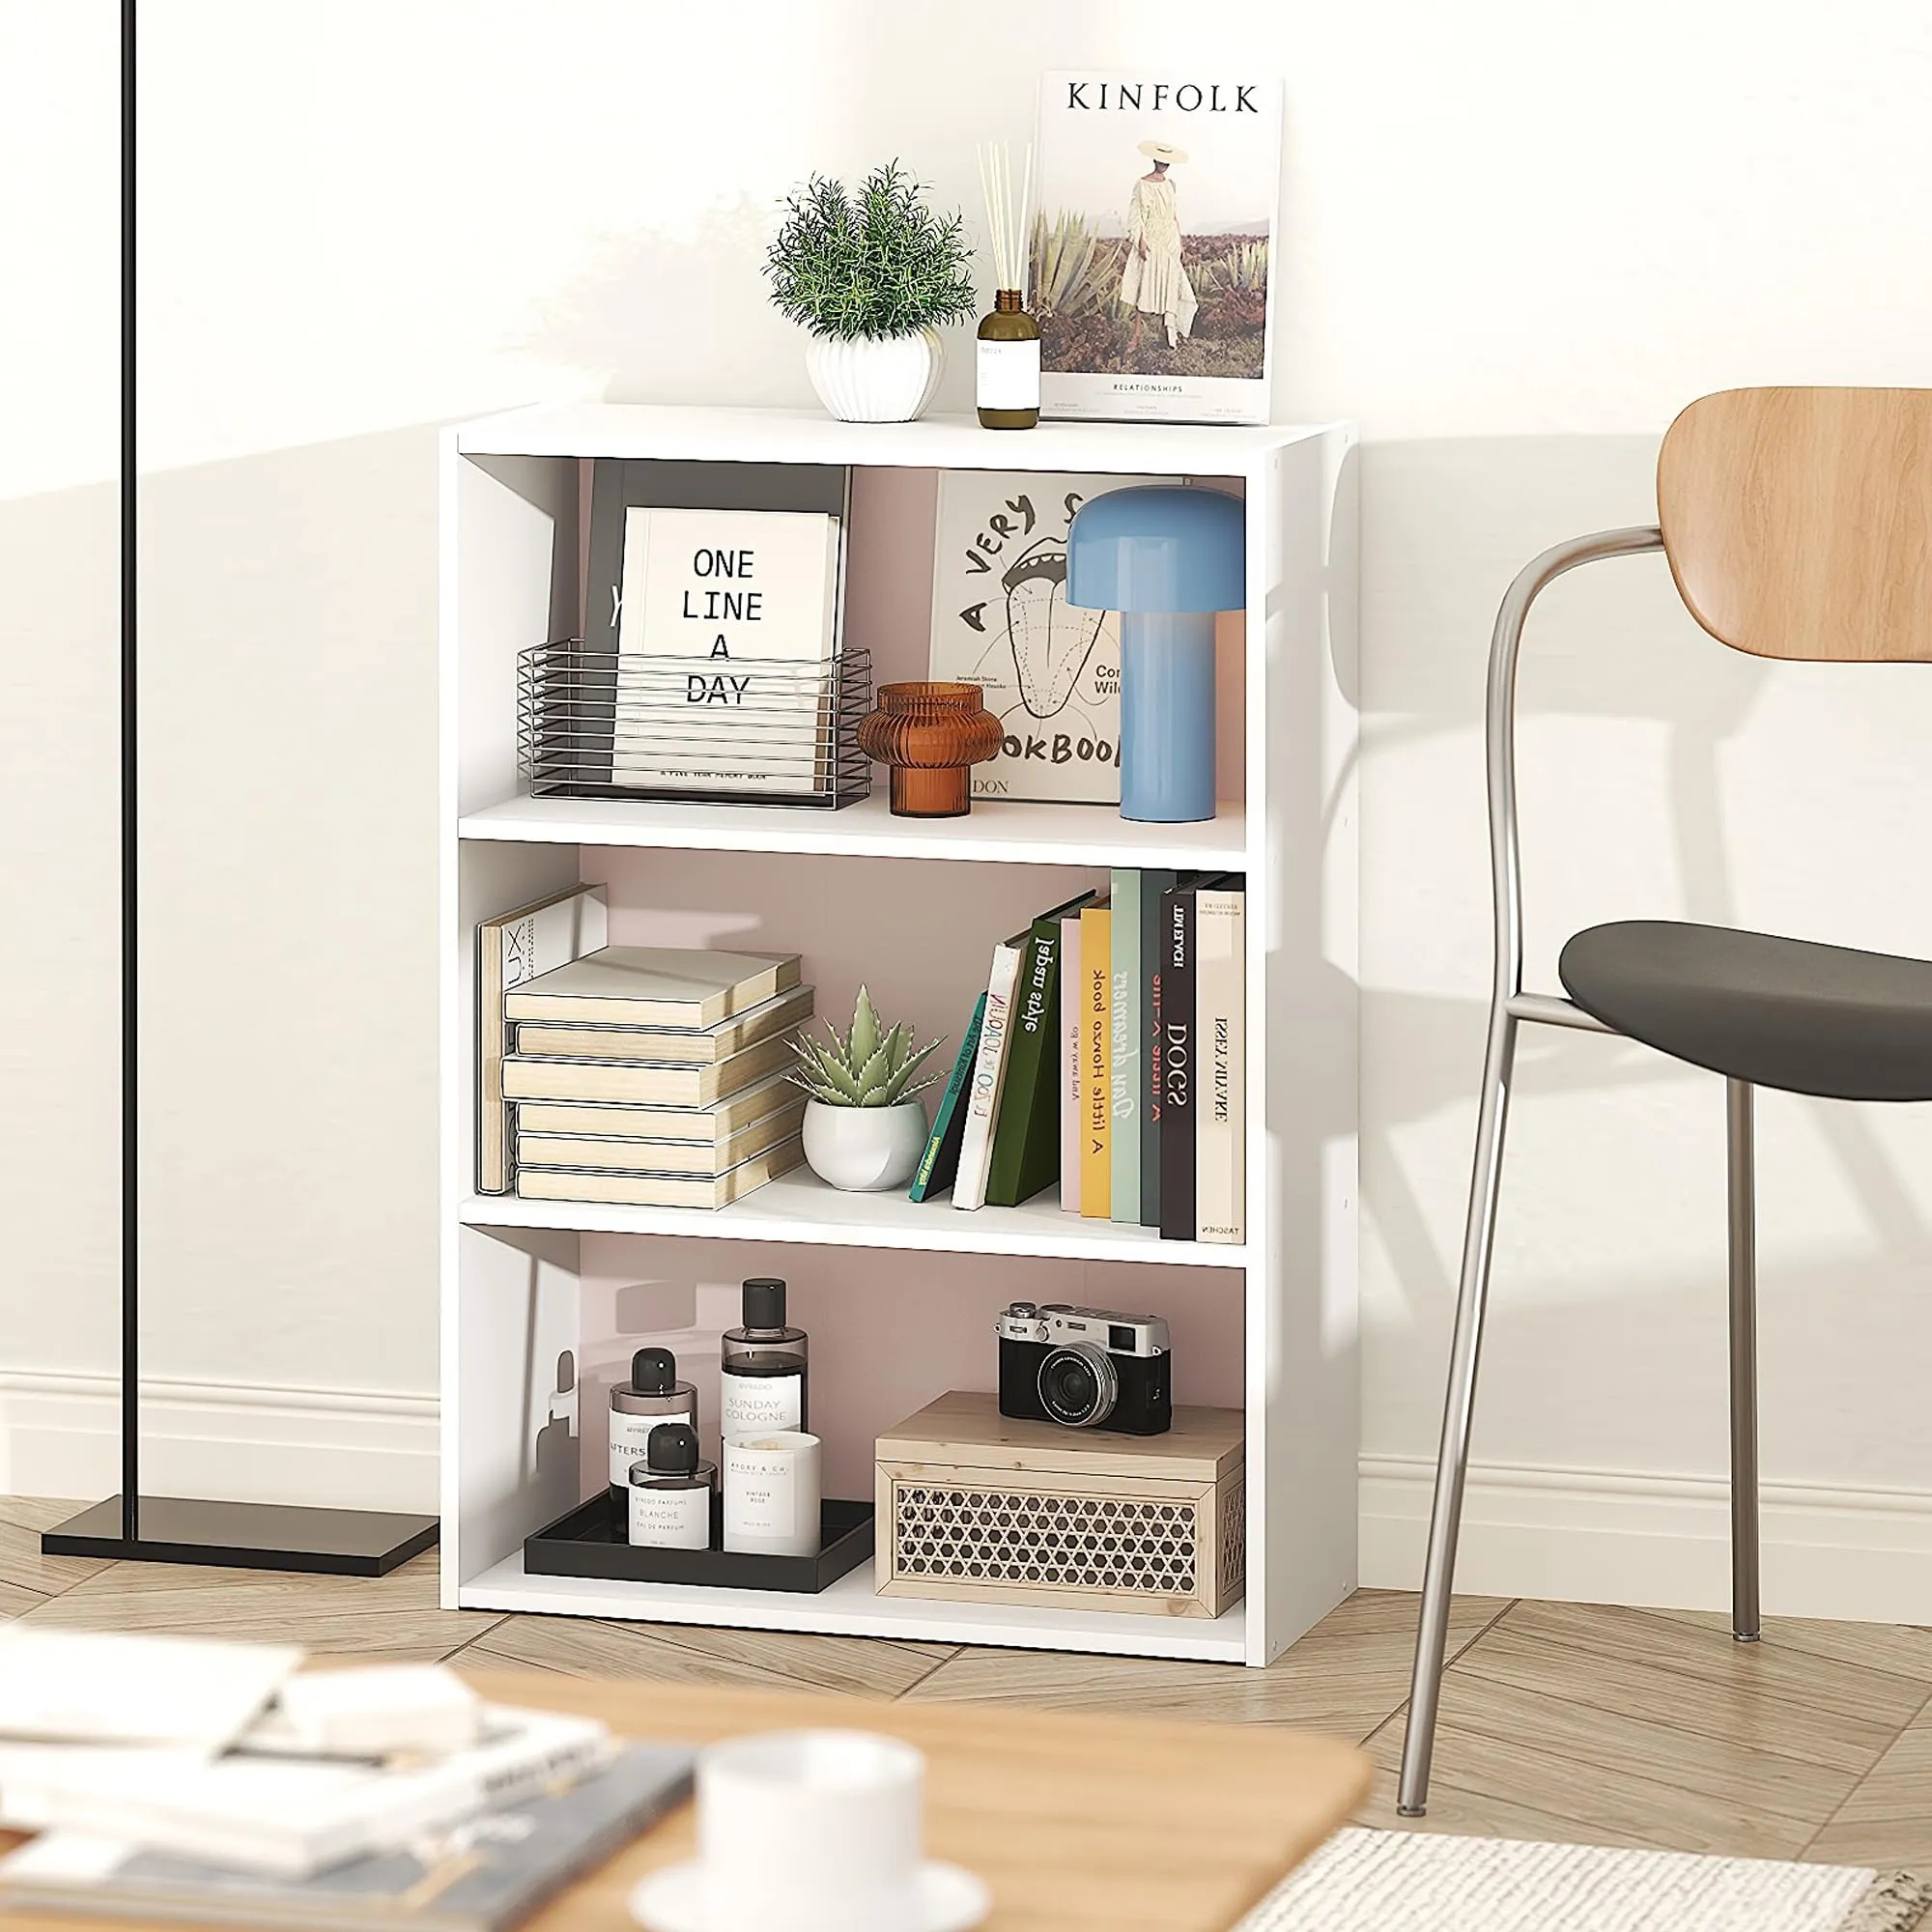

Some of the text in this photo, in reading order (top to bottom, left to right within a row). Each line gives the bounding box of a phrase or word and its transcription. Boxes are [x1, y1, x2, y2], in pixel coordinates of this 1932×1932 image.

[1067, 82, 1259, 113] KINFOLK
[1113, 384, 1183, 393] RELATIONSHIPS
[694, 549, 754, 579] ONE
[683, 590, 762, 621] LINE
[958, 602, 987, 632] A
[710, 634, 730, 662] A
[687, 675, 751, 704] DAY
[724, 1408, 788, 1422] COLOGNE
[728, 1397, 781, 1410] SUNDAY
[639, 1508, 679, 1520] BLANCHE
